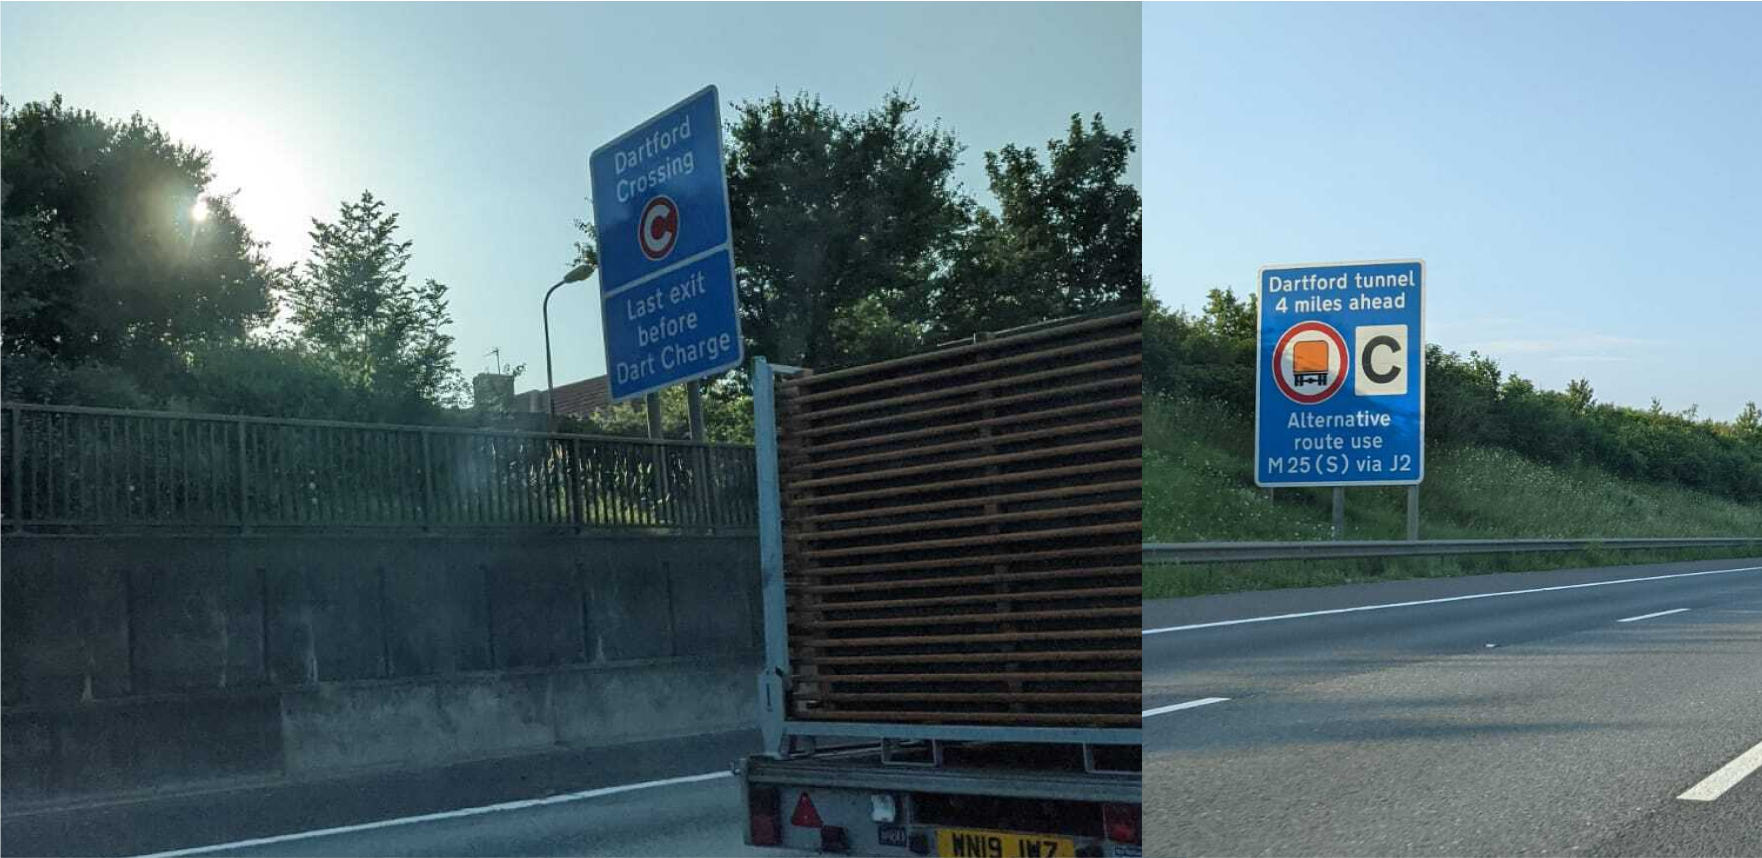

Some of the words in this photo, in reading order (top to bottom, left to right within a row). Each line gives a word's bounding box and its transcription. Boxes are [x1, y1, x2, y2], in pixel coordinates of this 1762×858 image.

[614, 116, 692, 174] Dartford
[616, 151, 694, 203] Crossing
[628, 285, 664, 321] Last
[670, 271, 706, 303] exit
[1269, 273, 1348, 292] Dartford
[1355, 271, 1415, 288] tunnel
[1275, 298, 1288, 313] 4
[1295, 296, 1342, 312] miles
[1349, 293, 1405, 310] ahead
[638, 311, 698, 347] before
[617, 356, 655, 385] Dart
[660, 331, 731, 370] Charge
[1362, 335, 1402, 384] C
[1288, 410, 1391, 428] Alternative
[1295, 434, 1344, 450] route
[1351, 436, 1383, 448] use
[1356, 456, 1382, 472] via
[1390, 454, 1412, 472] J2
